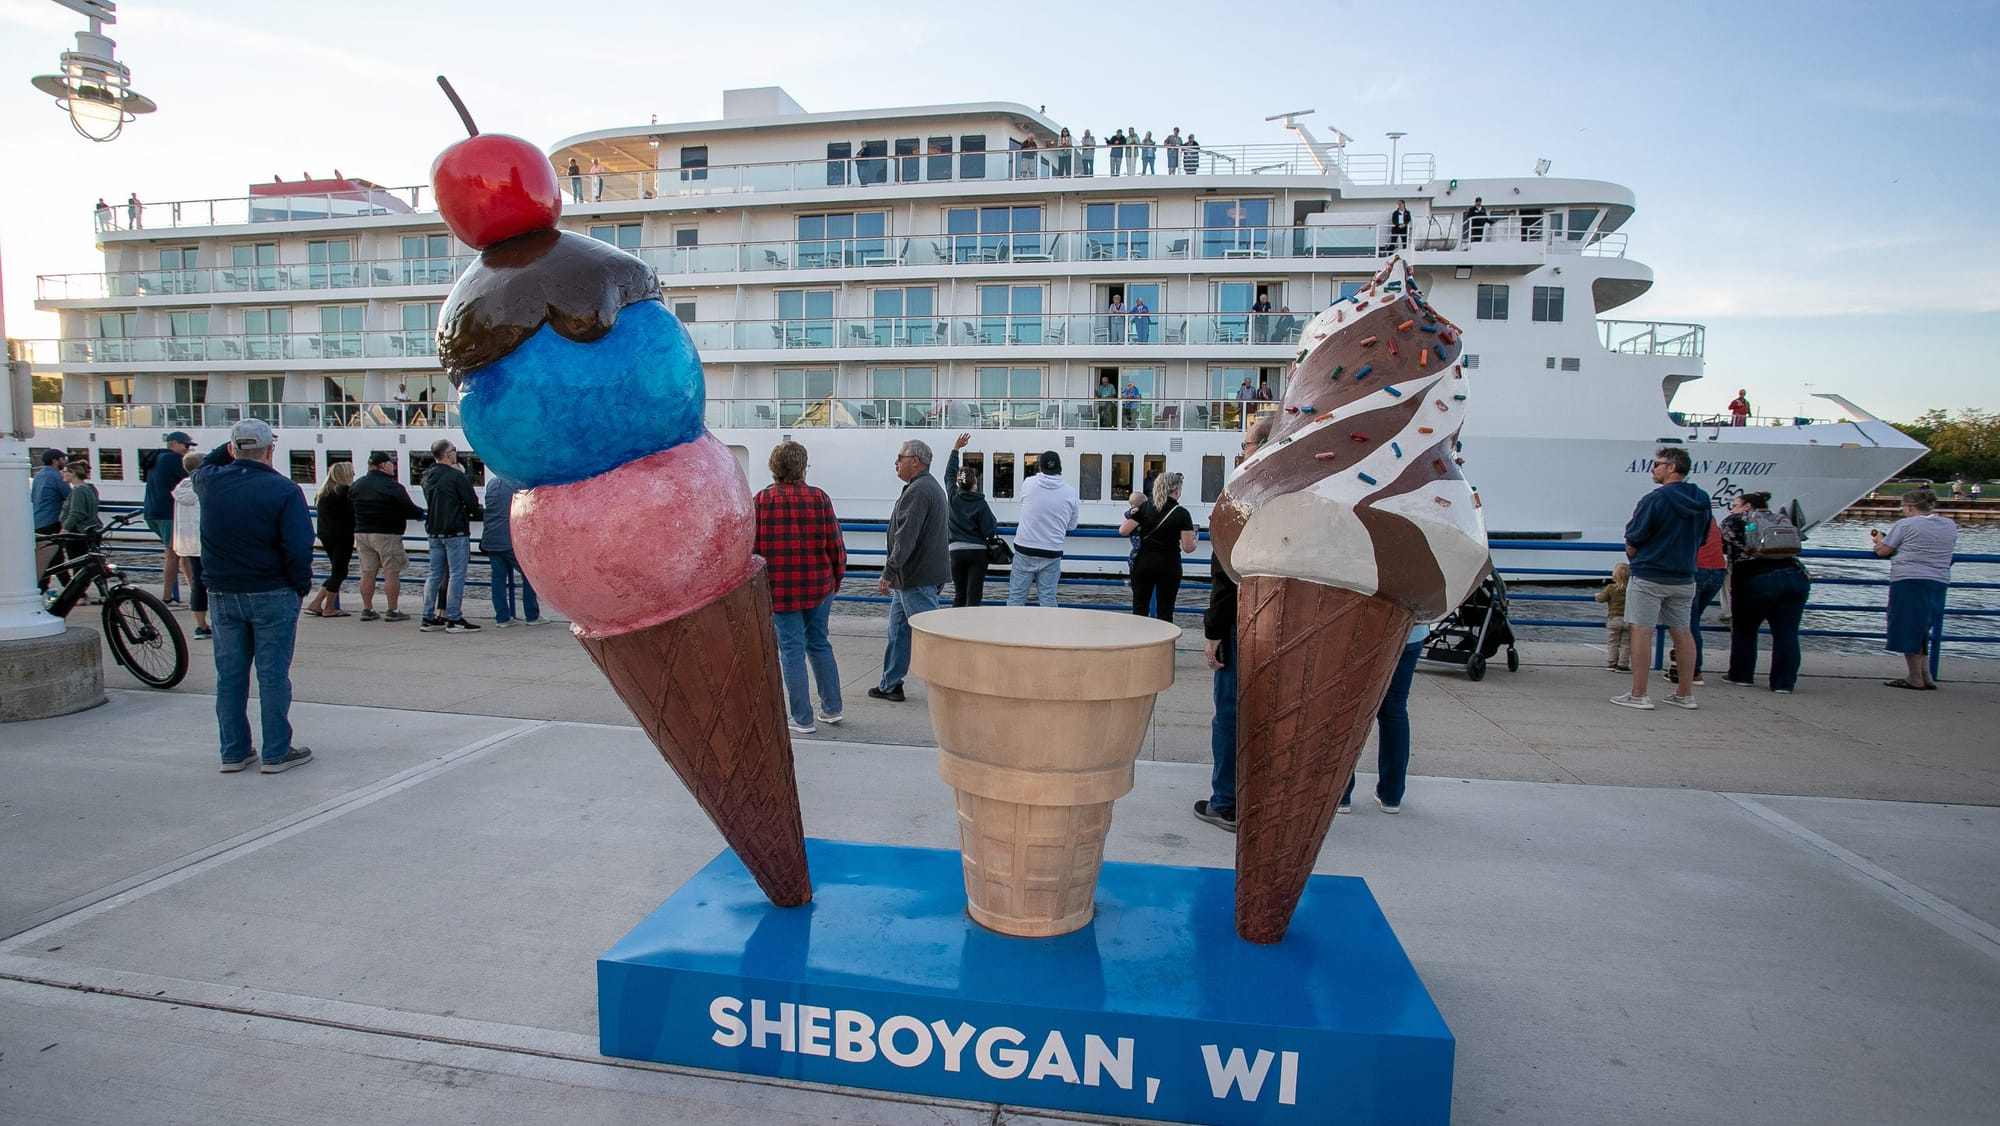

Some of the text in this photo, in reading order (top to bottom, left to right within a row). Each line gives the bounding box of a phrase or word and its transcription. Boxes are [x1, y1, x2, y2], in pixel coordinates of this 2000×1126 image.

[1625, 459, 1776, 476] AMAN PATRIOT
[710, 997, 1299, 1105] SHEBOYGAN, WI
